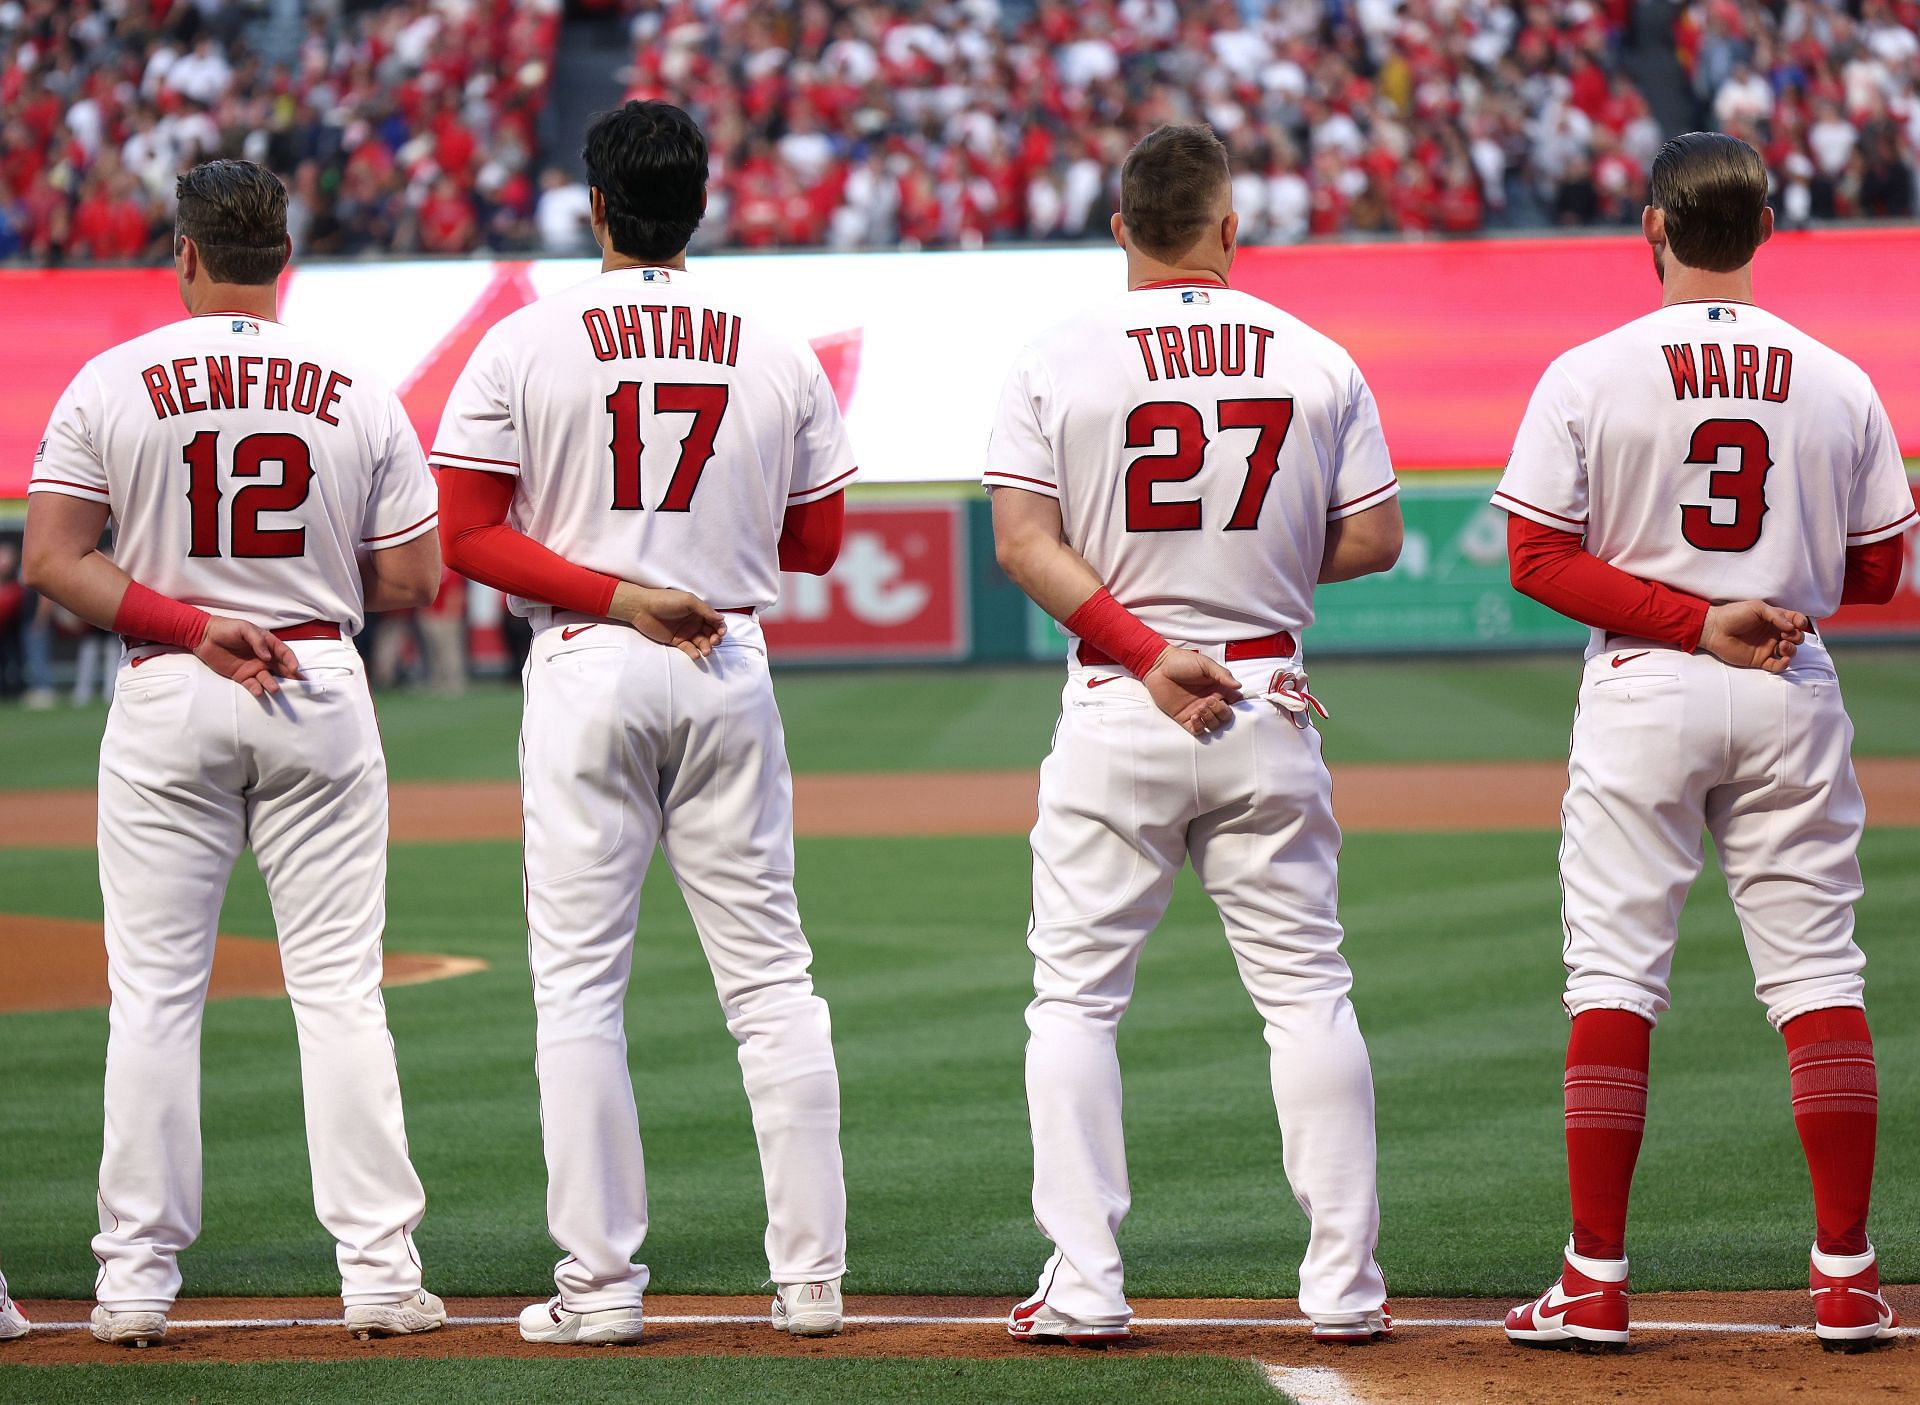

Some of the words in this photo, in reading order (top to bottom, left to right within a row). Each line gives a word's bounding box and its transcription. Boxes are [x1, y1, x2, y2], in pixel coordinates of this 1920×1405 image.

[582, 305, 741, 367] OHTANI
[1126, 324, 1274, 381] TROUT
[142, 356, 352, 427] RENFROE
[1661, 343, 1792, 403] WARD
[606, 381, 728, 512] 17
[1124, 398, 1293, 532] 27
[183, 431, 315, 558] 12
[1680, 419, 1774, 552] 3
[810, 1284, 824, 1300] 17
